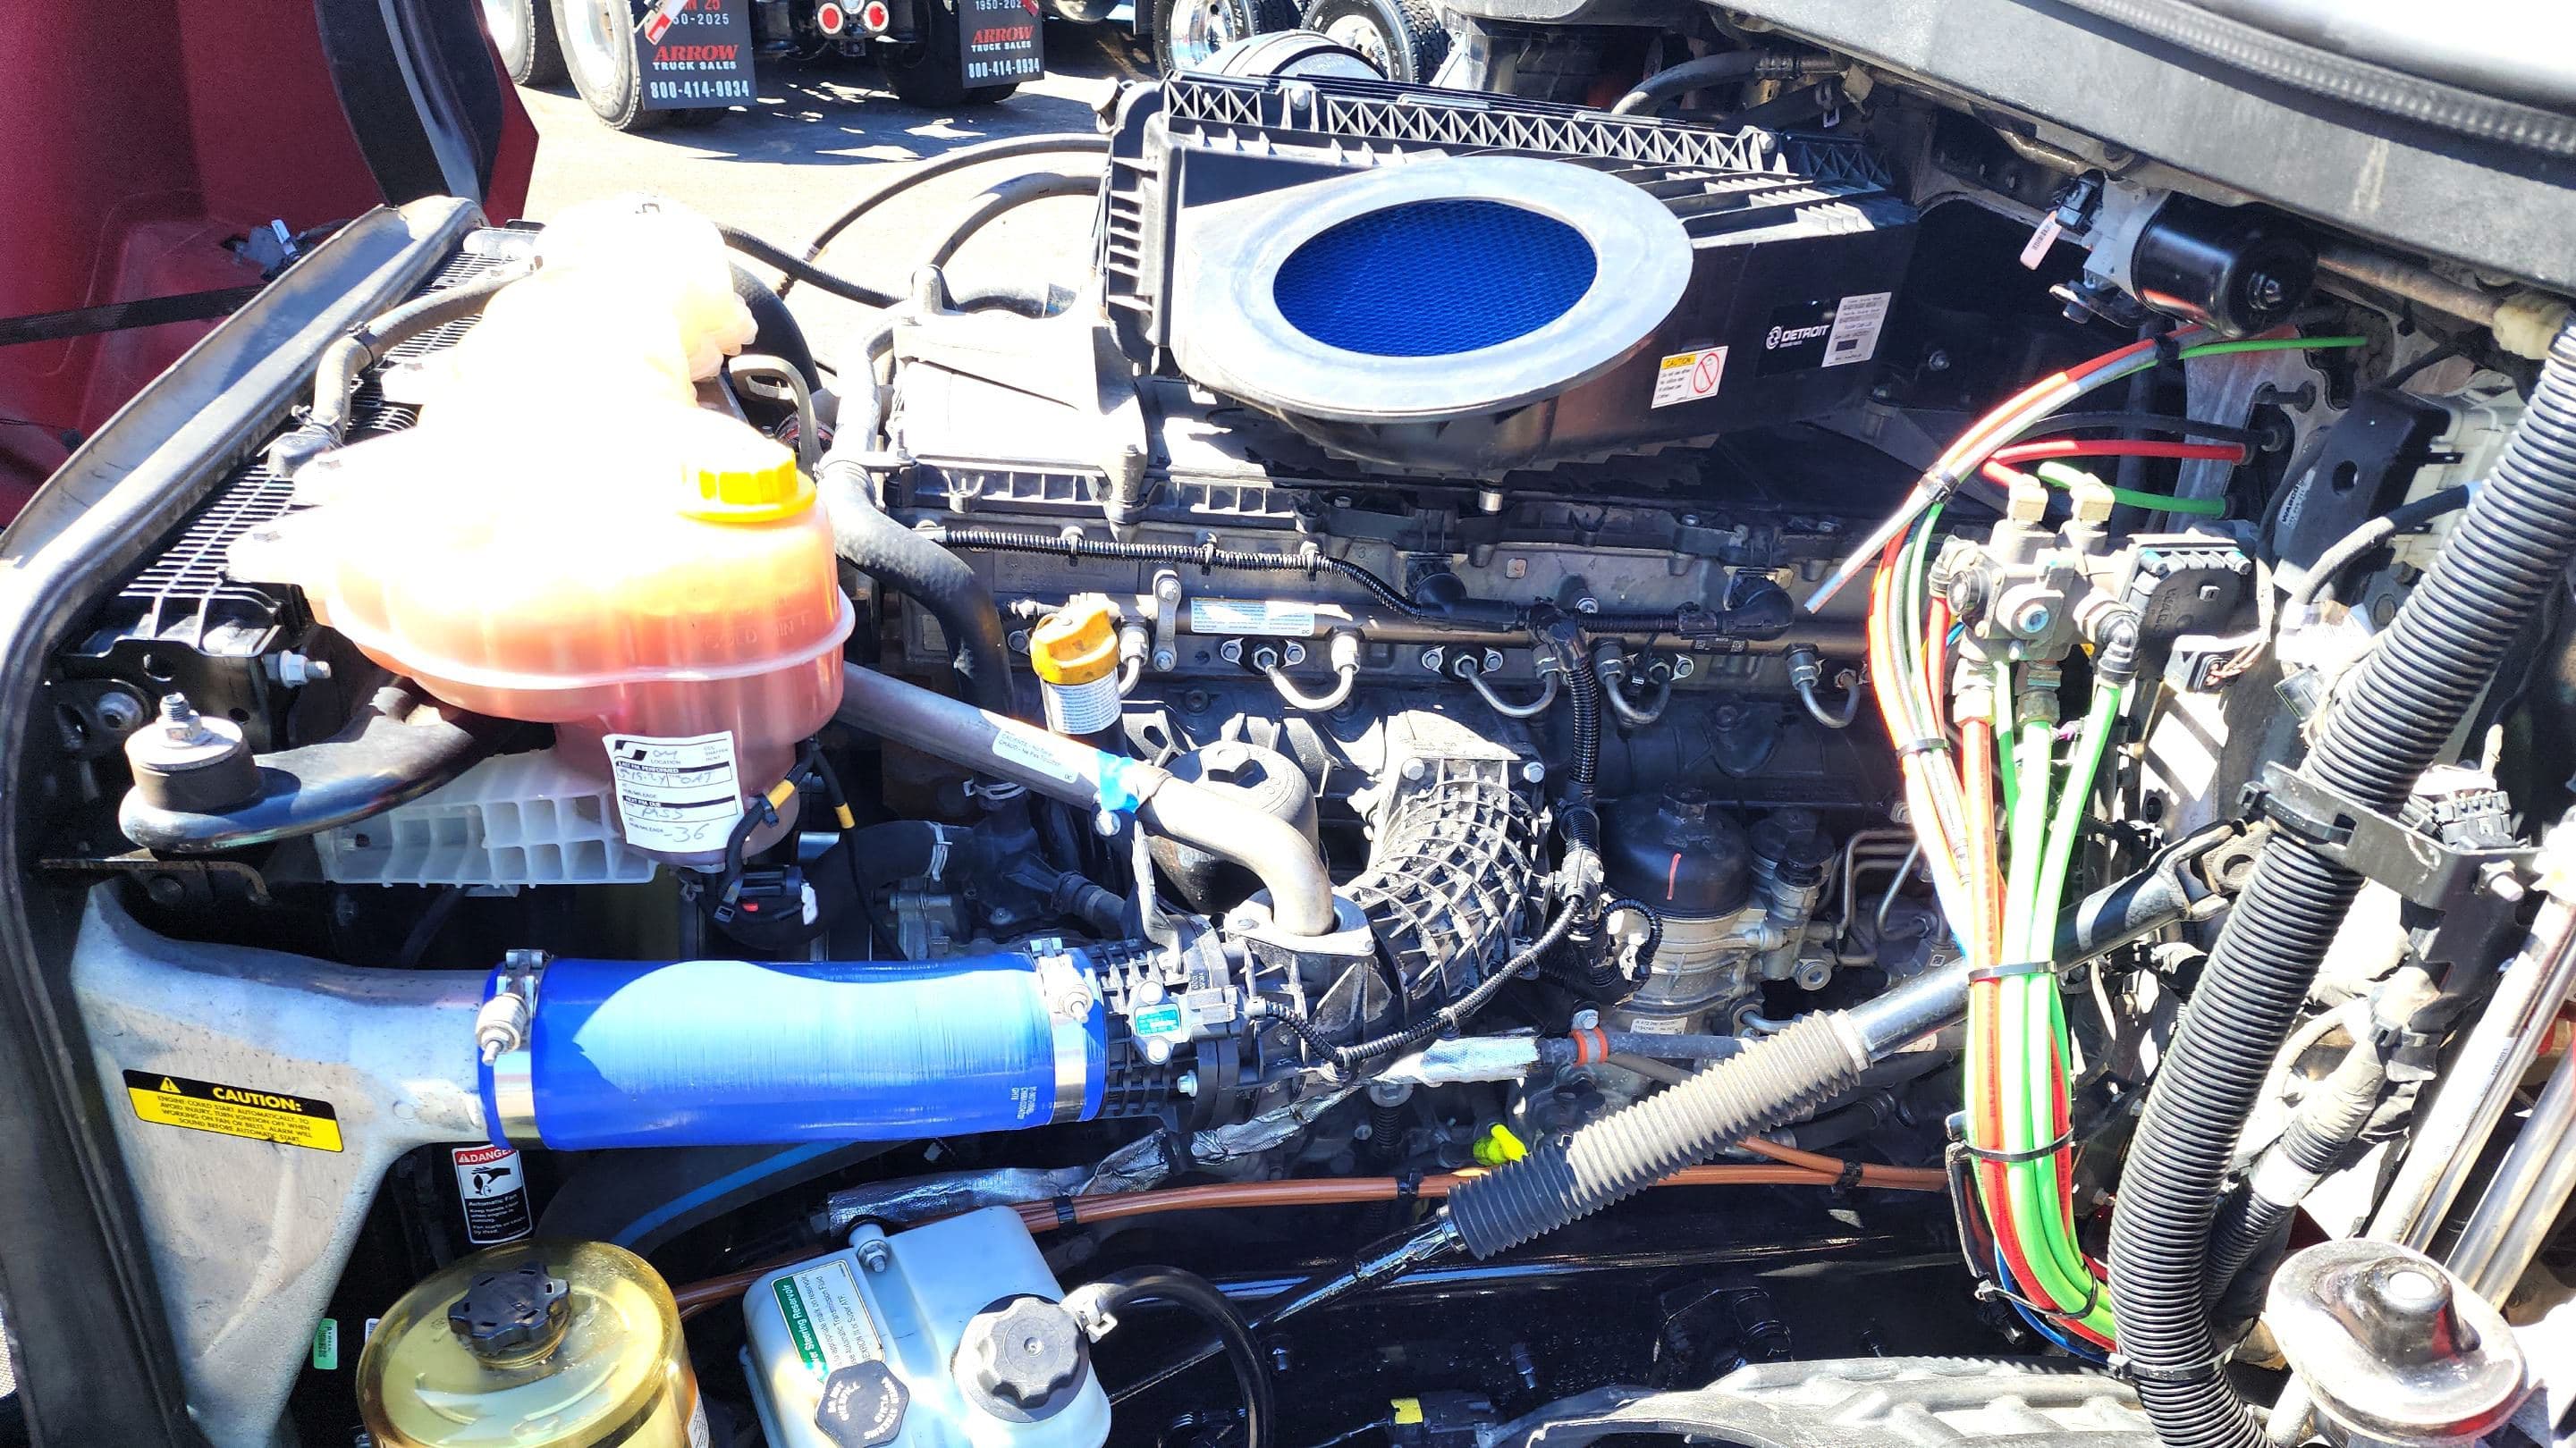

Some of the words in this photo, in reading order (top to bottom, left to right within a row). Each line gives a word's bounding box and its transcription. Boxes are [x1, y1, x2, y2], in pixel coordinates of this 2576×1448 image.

[976, 0, 1026, 11] 1950-202
[671, 13, 730, 25] 50-2025
[973, 25, 1035, 44] ARROW
[653, 44, 739, 61] ARROW
[971, 43, 1001, 53] TRUCK
[1005, 40, 1031, 50] SALES
[653, 62, 695, 71] TRUCK
[699, 61, 737, 70] SALES
[1781, 324, 1830, 341] DETROIT
[2282, 485, 2299, 522] WABCO
[188, 1099, 213, 1109] COULD
[213, 1086, 303, 1112] CAUTION:
[160, 1102, 182, 1112] AVOID
[215, 1110, 234, 1119] TURN
[236, 1114, 269, 1124] IGNITION
[288, 1122, 310, 1131] WHEN
[162, 1109, 198, 1120] WORKING
[201, 1115, 214, 1123] ON
[215, 1116, 230, 1124] FAN
[232, 1119, 244, 1127] OR
[269, 1125, 293, 1135] ALARM
[180, 1117, 206, 1127] SOUND
[207, 1121, 234, 1132] BEFORE
[470, 1149, 511, 1162] DANGE
[469, 1199, 503, 1207] Automatic
[782, 1284, 802, 1319] Reservoir
[798, 1318, 815, 1350] Steering
